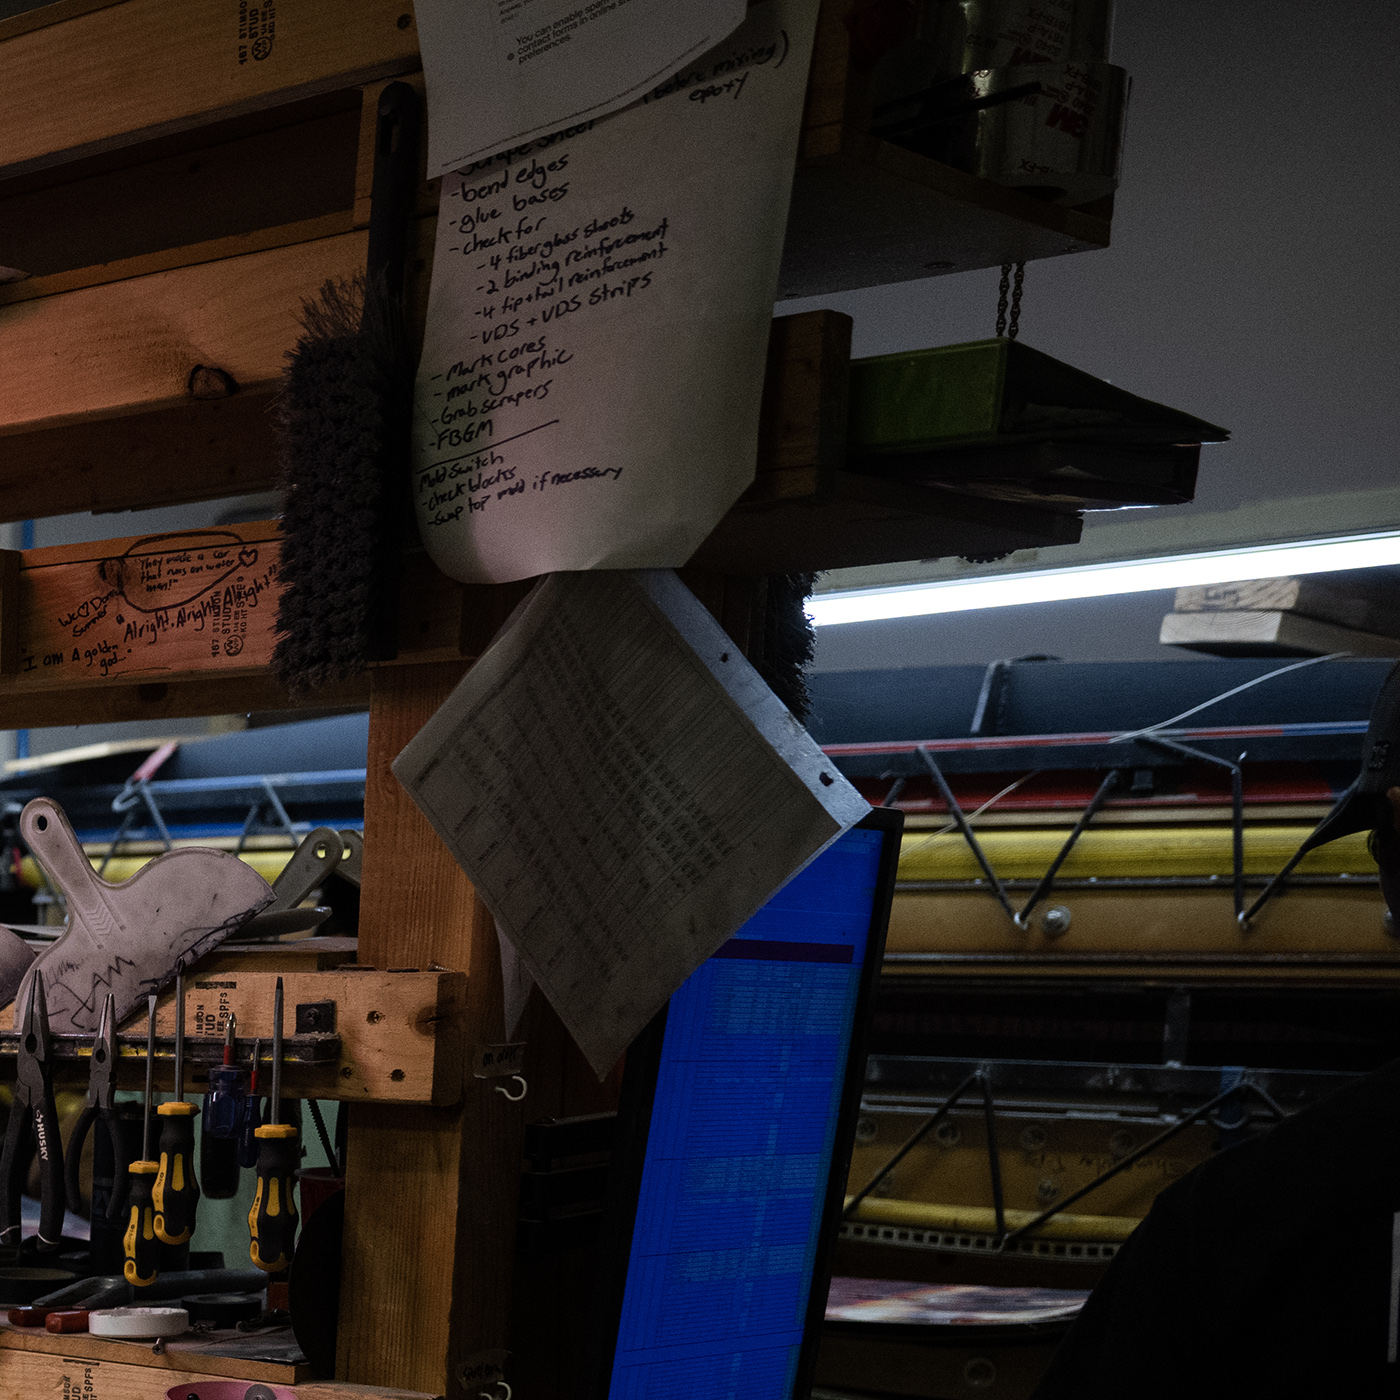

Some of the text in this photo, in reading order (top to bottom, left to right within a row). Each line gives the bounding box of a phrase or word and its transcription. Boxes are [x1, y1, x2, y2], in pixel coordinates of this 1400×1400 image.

[249, 8, 259, 39] STUD
[515, 9, 584, 46] You can enable
[517, 2, 617, 55] contact forms in online
[687, 71, 750, 104] epoxy
[1044, 103, 1090, 138] 3M
[514, 152, 571, 190] edges
[512, 182, 571, 212] bases
[515, 216, 548, 241] for
[503, 260, 561, 290] binding
[496, 335, 548, 364] cores
[488, 348, 575, 397] graphic
[479, 379, 554, 415] scrapers
[531, 470, 551, 492] if
[166, 551, 192, 564] made
[212, 550, 231, 560] car
[190, 564, 204, 574] on
[42, 652, 64, 669] am
[37, 1122, 49, 1162] HUSKY
